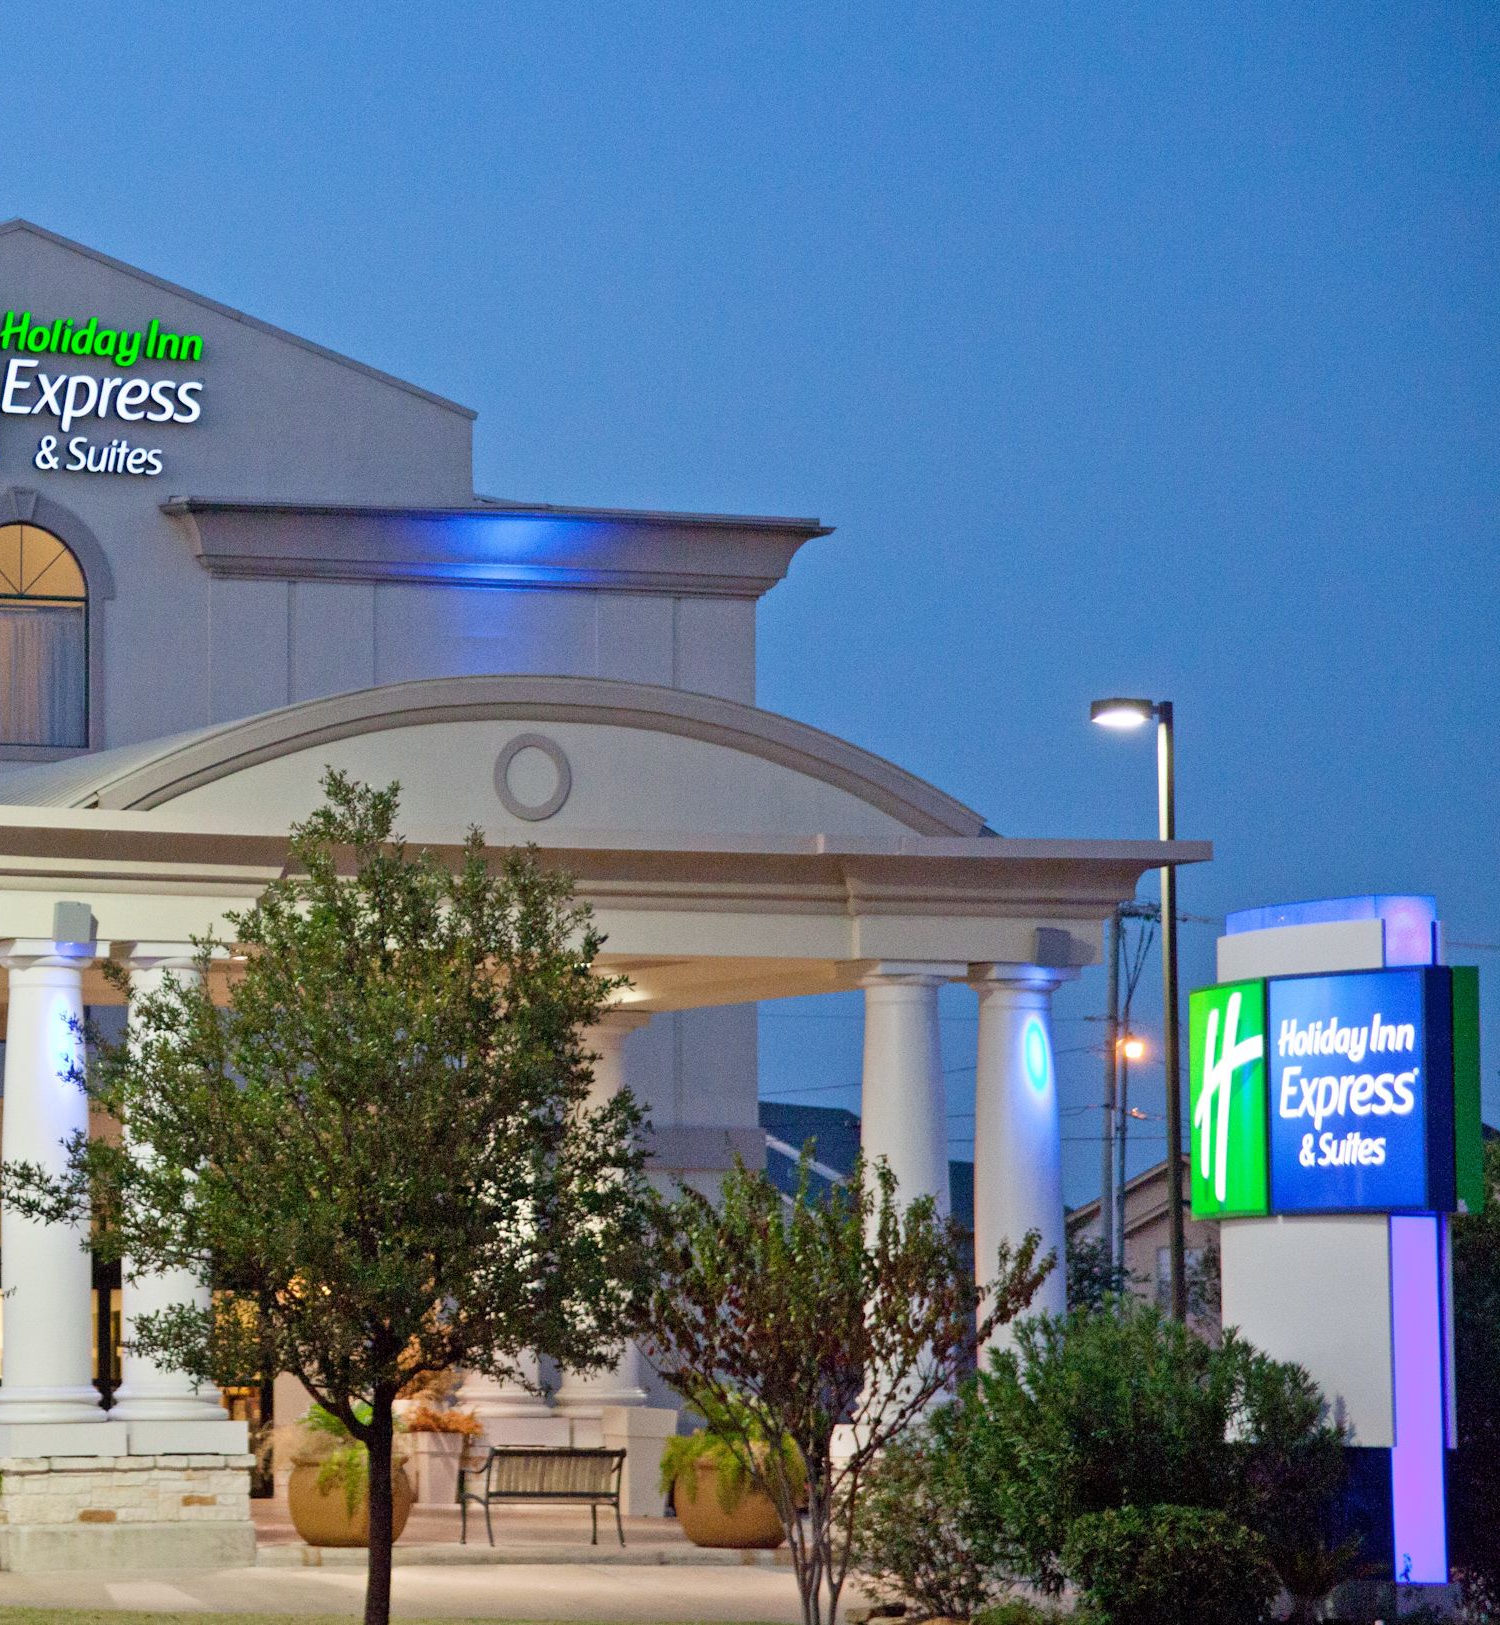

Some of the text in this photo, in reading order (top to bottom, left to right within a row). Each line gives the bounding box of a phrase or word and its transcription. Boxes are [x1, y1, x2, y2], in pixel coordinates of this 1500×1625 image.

[0, 309, 204, 367] Holiday Inn
[0, 357, 204, 433] Express
[34, 434, 164, 476] & Suites
[1277, 1012, 1416, 1063] Holiday Inn
[1278, 1065, 1417, 1131] Express
[1298, 1131, 1387, 1167] & Suites
